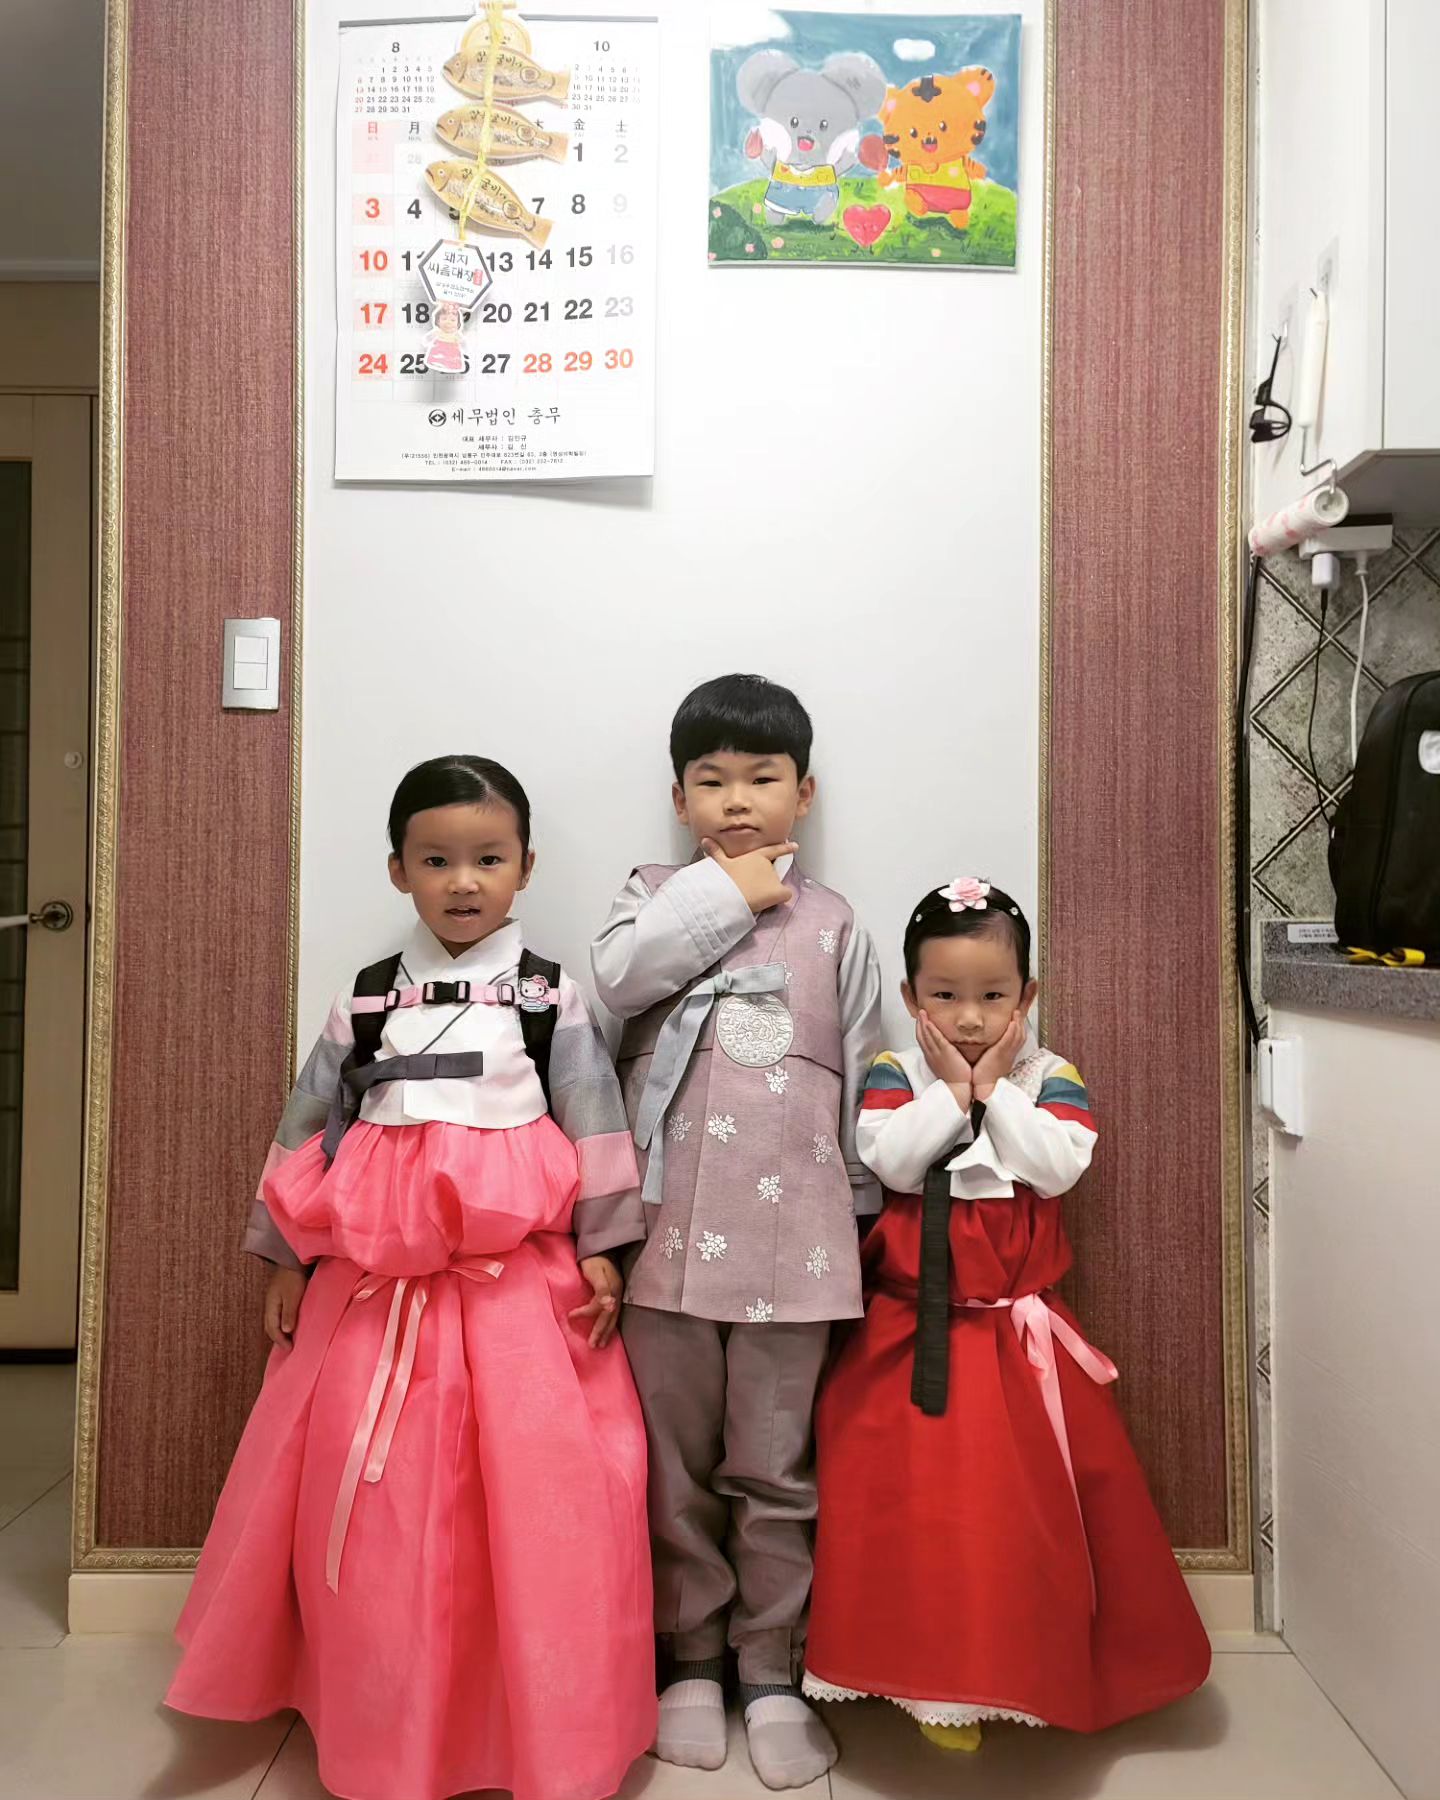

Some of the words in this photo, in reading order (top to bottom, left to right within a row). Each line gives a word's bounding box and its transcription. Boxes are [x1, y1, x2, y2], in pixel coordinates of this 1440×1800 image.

[391, 41, 400, 53] 8
[593, 40, 610, 52] 10
[403, 75, 411, 83] 10
[414, 75, 423, 83] 11
[390, 85, 399, 93] 16
[402, 85, 411, 93] 17
[414, 85, 423, 93] 18
[401, 95, 411, 103] 24
[413, 95, 423, 103] 25
[378, 105, 387, 113] 29
[389, 105, 399, 113] 30
[401, 105, 411, 113] 31
[368, 121, 378, 134] 日
[408, 121, 420, 134] 月
[573, 118, 585, 131] 金
[615, 119, 628, 133] 土
[573, 142, 583, 162] 1
[614, 144, 629, 163] 2
[366, 198, 380, 219] 3
[406, 199, 422, 219] 4
[531, 197, 545, 215] 7
[571, 194, 585, 214] 8
[613, 193, 628, 213] 9
[360, 251, 388, 271] 10
[401, 250, 424, 271] 1
[487, 251, 513, 272] 13
[525, 250, 553, 271] 14
[566, 246, 593, 267] 15
[606, 244, 634, 264] 16
[443, 251, 468, 266] 돼지
[428, 262, 474, 282] 씨름대장
[360, 303, 388, 325] 17
[401, 303, 430, 324] 18
[482, 303, 512, 323] 20
[524, 302, 550, 322] 21
[564, 299, 593, 320] 22
[604, 297, 634, 317] 23
[359, 354, 388, 374] 24
[400, 354, 429, 374] 25
[482, 354, 511, 374] 27
[523, 353, 552, 373] 28
[564, 352, 593, 372] 29
[605, 348, 634, 369] 30
[452, 408, 515, 426] 세무법인
[527, 407, 561, 425] 충무
